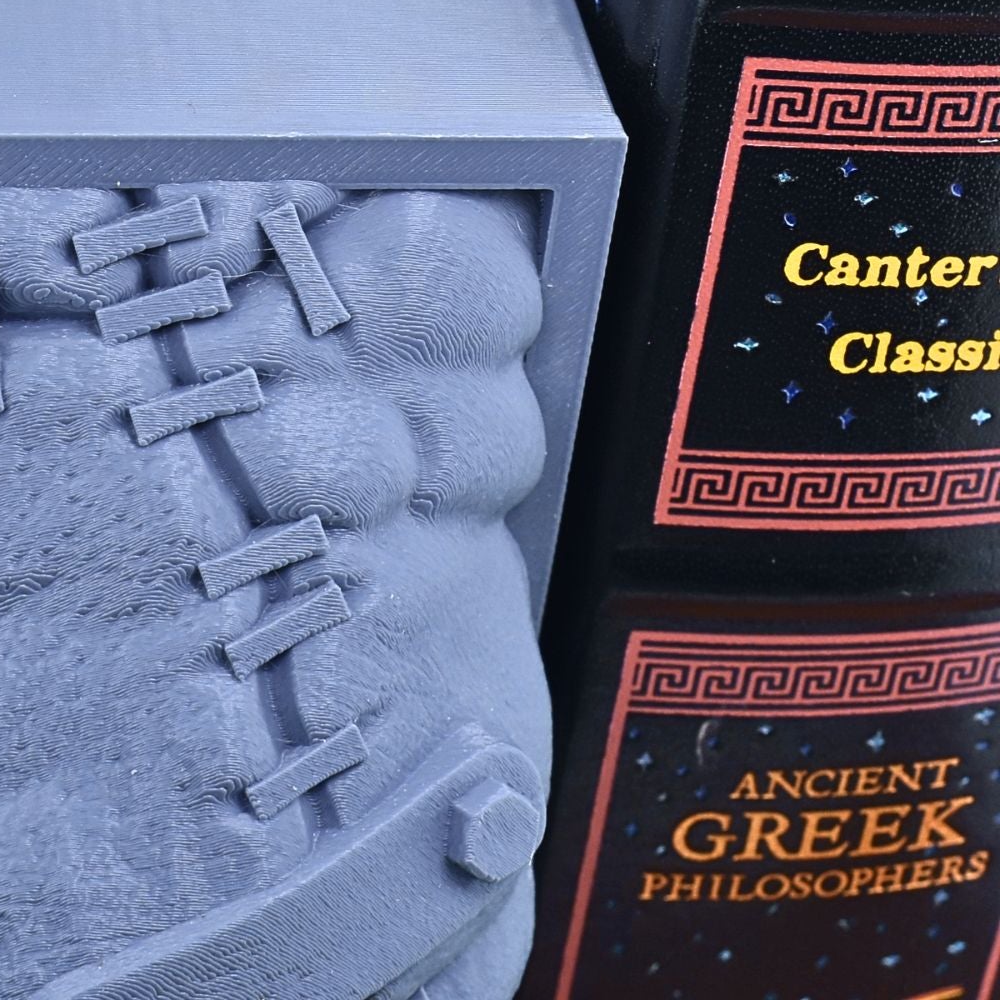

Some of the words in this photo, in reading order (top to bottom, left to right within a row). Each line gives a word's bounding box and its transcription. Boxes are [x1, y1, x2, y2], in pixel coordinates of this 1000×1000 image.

[783, 242, 1000, 288] Canter
[829, 330, 1000, 374] Classi
[729, 757, 960, 799] ANCIENT
[672, 795, 975, 862] GREEK
[638, 850, 990, 901] PHILOSOPHERS
